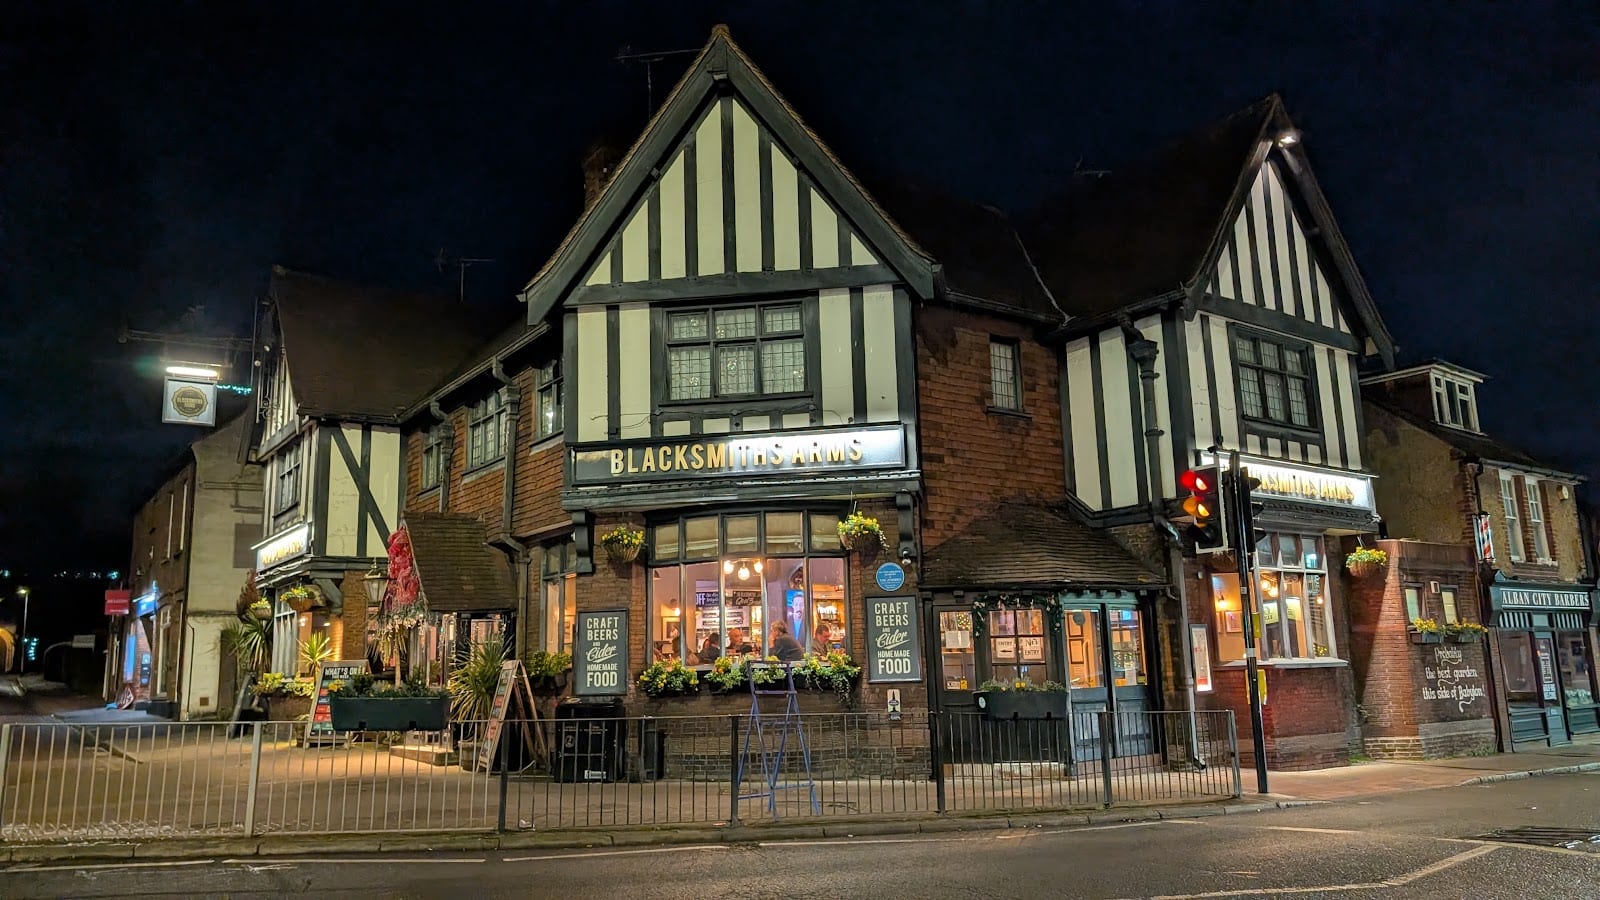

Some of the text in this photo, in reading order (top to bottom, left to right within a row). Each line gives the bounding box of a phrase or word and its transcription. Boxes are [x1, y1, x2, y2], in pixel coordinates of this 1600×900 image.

[610, 437, 863, 475] BLACKSMITHS ARMS
[1502, 591, 1590, 607] ALBAN CITY BARBERS
[875, 602, 909, 615] CRAFT
[586, 616, 619, 629] CRAFT
[875, 614, 909, 627] BEERS
[587, 628, 619, 641] BEERS
[875, 628, 909, 649] Cider
[585, 643, 618, 663] Cider
[877, 649, 911, 658] HOMEMADE
[1434, 646, 1462, 665] Probably
[324, 667, 349, 676] WHAT'S
[586, 663, 618, 672] HOMEMADE
[878, 658, 911, 675] FOOD
[1425, 665, 1478, 682] the best garden
[586, 671, 618, 688] FOOD
[1422, 684, 1486, 704] this side of Babylon!
